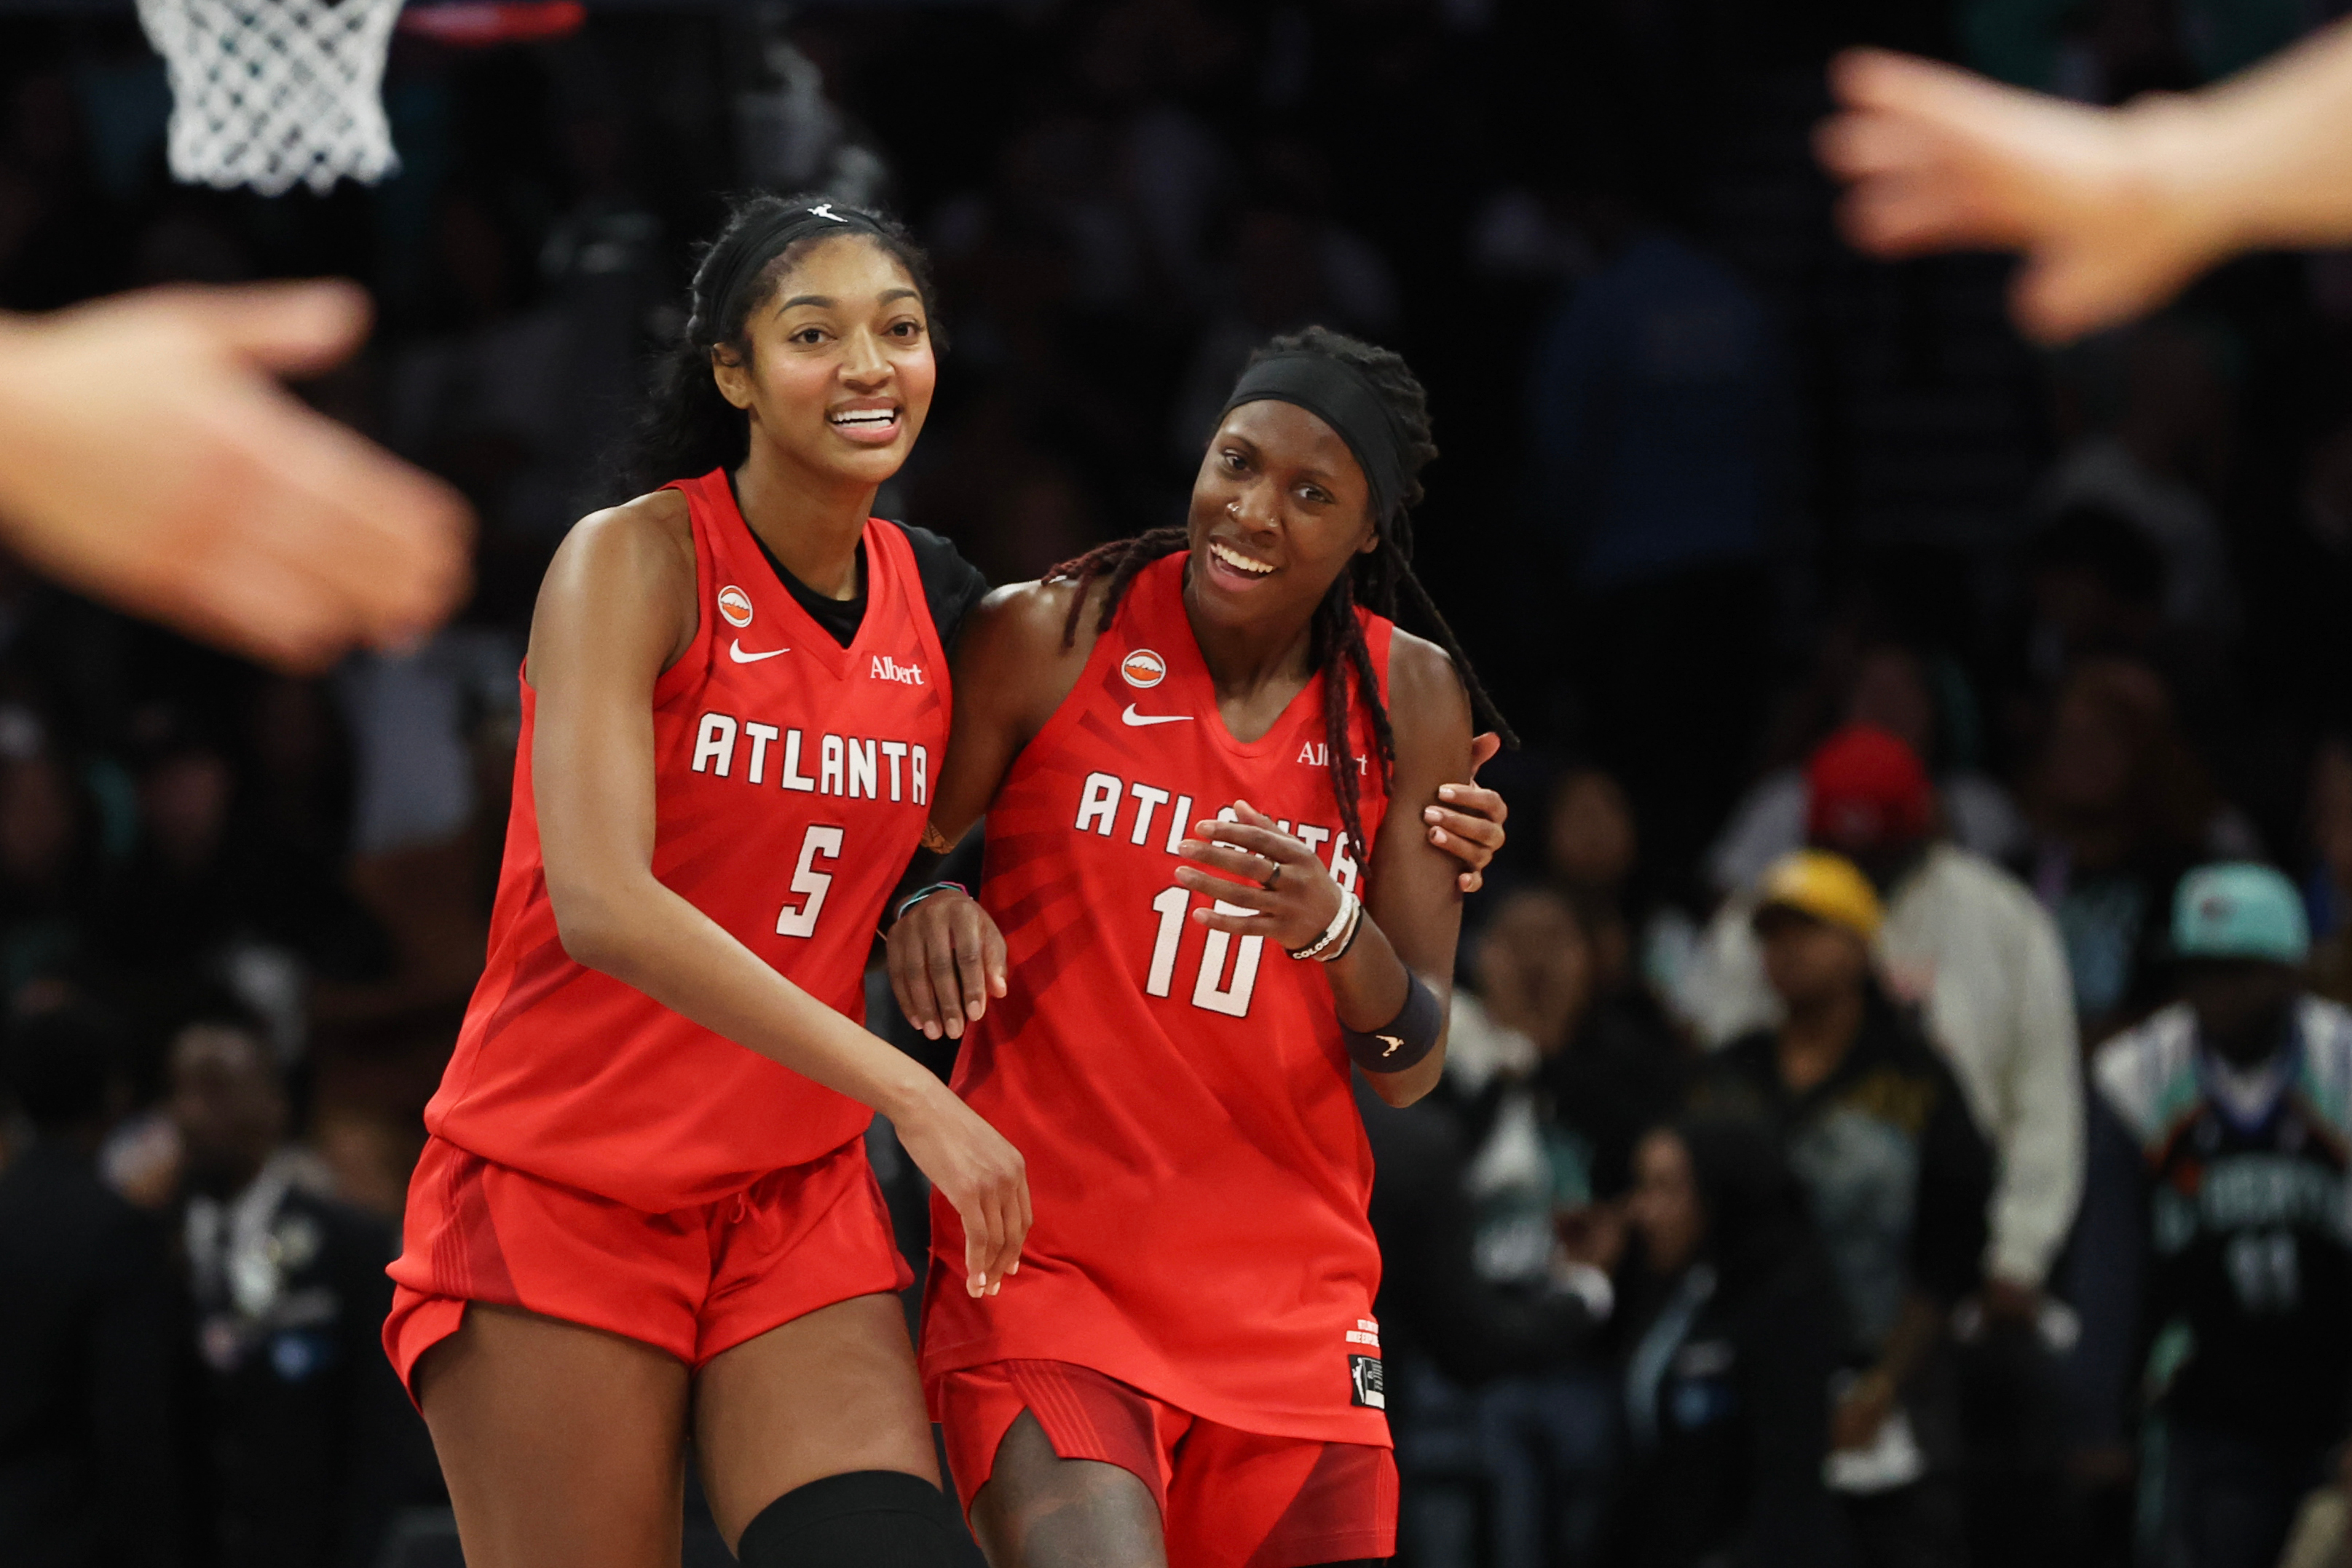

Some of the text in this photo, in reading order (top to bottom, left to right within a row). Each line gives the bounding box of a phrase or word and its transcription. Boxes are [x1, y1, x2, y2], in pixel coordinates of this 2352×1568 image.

[870, 655, 924, 685] Albert
[692, 712, 926, 805] ATLANTA
[776, 824, 844, 938] 5
[1147, 886, 1264, 1018] 10
